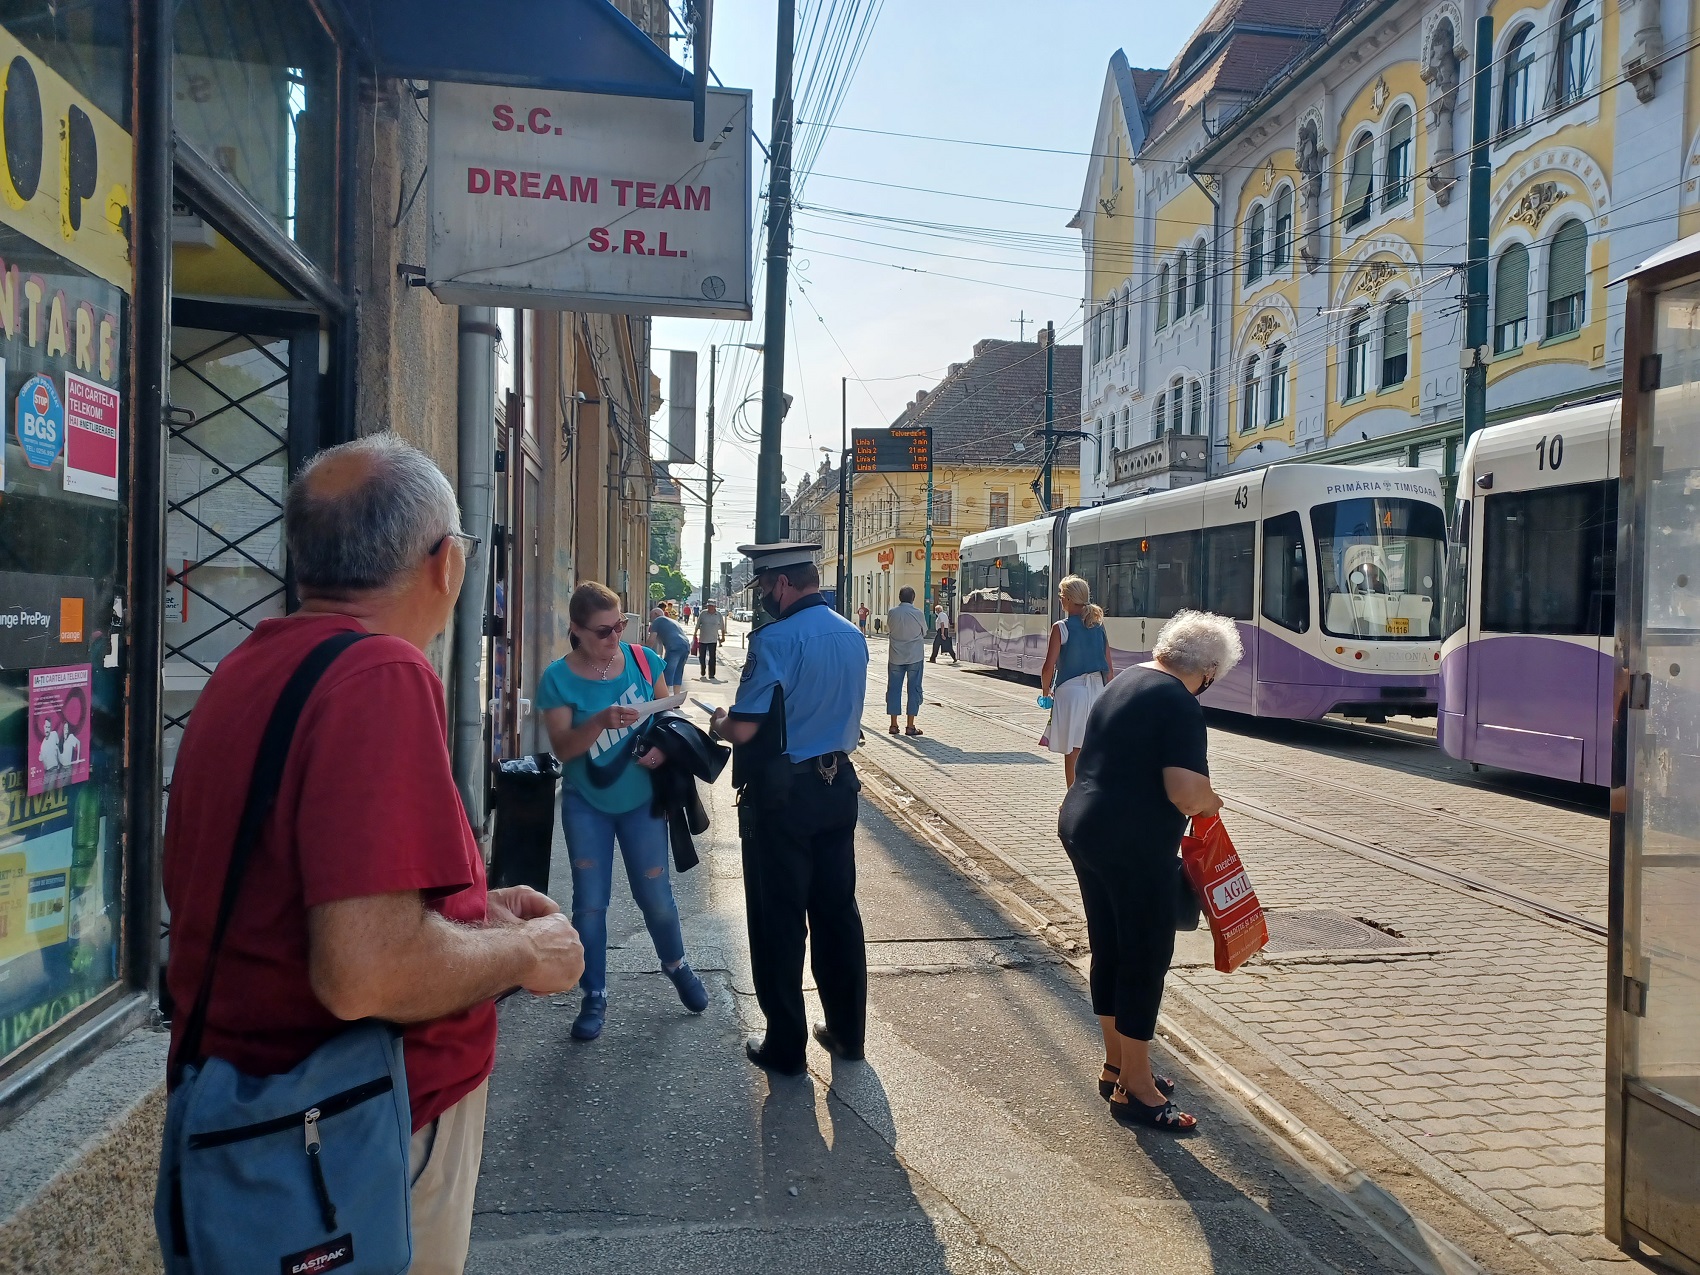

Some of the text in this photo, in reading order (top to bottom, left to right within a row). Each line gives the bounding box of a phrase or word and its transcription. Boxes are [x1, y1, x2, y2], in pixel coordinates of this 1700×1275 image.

[492, 104, 563, 136] S.C.
[467, 167, 711, 211] DREAM TEAM
[588, 228, 688, 258] S.R.L.
[34, 394, 48, 407] STOP
[70, 381, 114, 409] AICI CARTELA
[70, 397, 103, 420] TELEKOM!
[24, 412, 57, 443] BGS
[70, 415, 79, 426] HAI
[908, 446, 916, 454] 21
[1535, 434, 1563, 471] 10
[1234, 485, 1248, 510] 43
[1327, 480, 1381, 495] PRIMĂRIA
[1383, 511, 1392, 528] 4
[915, 548, 959, 561] Crref
[0, 611, 51, 629] nge PrePay
[61, 631, 81, 641] orange
[46, 673, 66, 683] CARTELA
[67, 671, 87, 681] TELEKOM
[292, 1248, 345, 1274] EASTPAK
